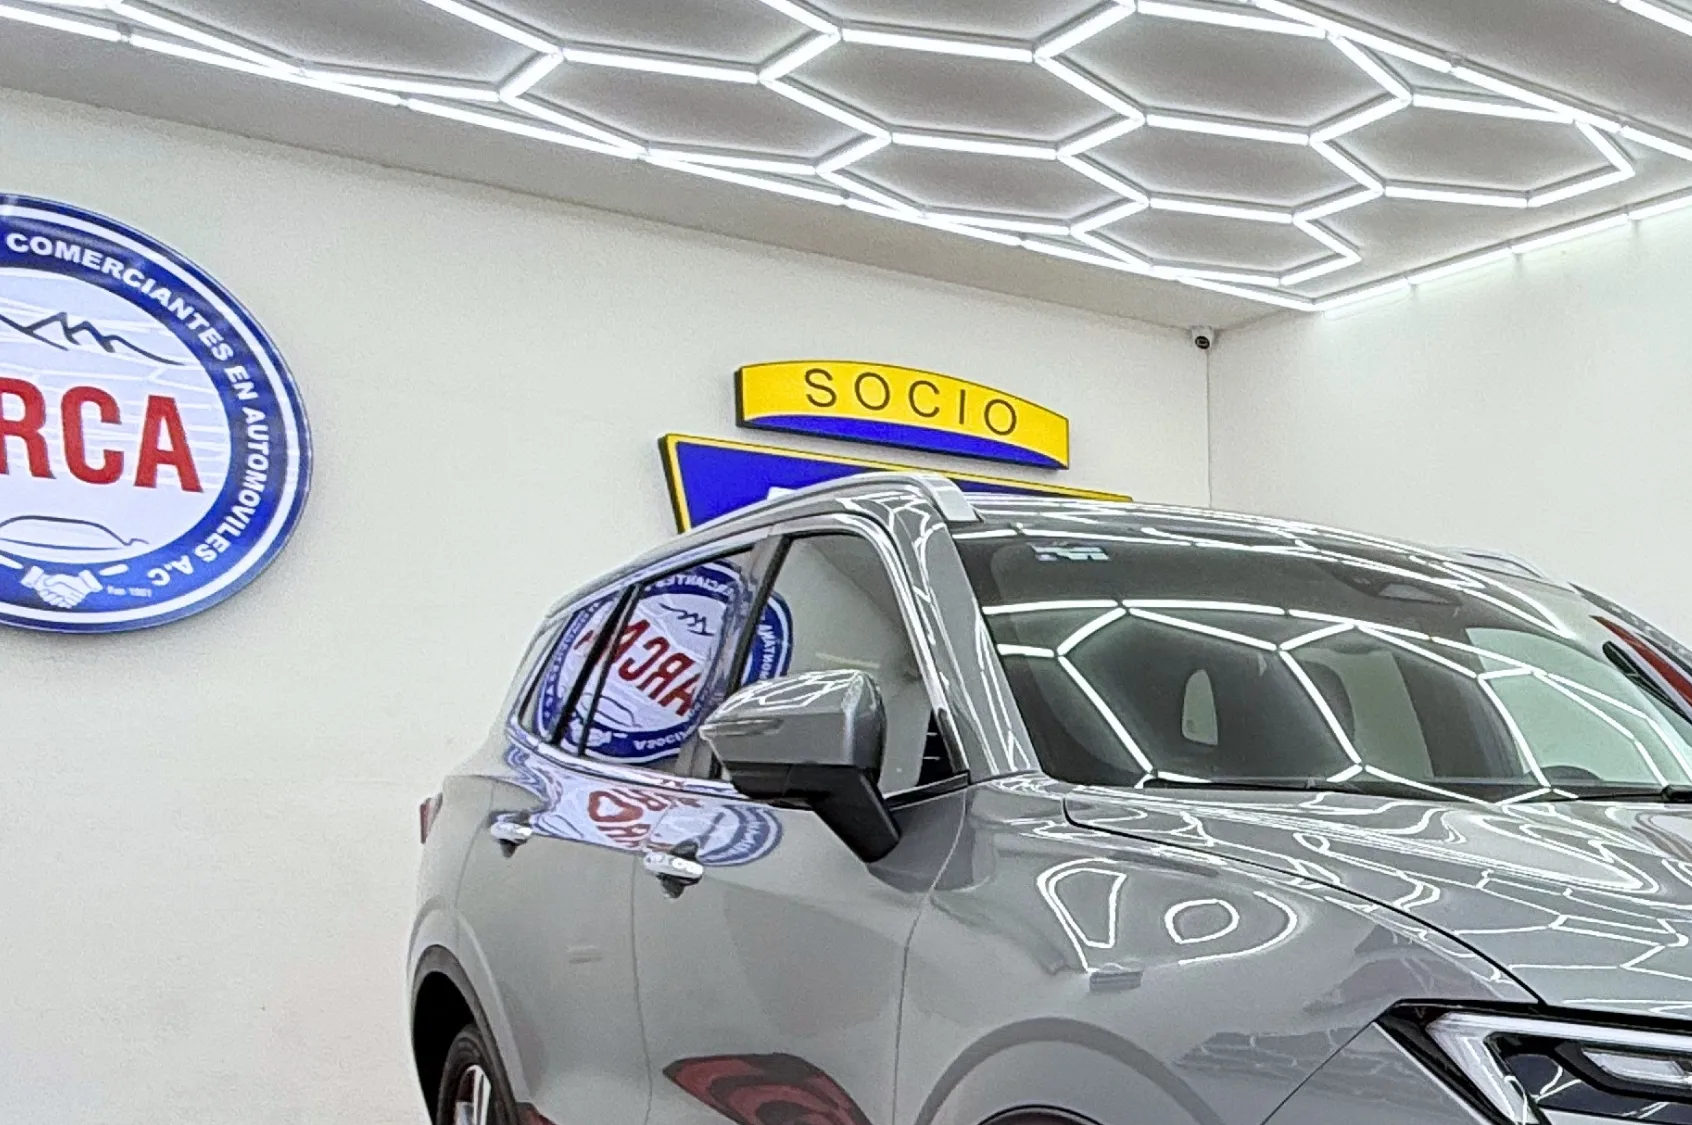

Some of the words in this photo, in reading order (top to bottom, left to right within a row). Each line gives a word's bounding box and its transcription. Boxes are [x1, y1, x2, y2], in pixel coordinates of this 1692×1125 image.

[6, 232, 234, 361] COMERCIANTES
[224, 365, 258, 400] EN
[804, 367, 1017, 436] SOCIO
[194, 406, 269, 563] AUTOMOVILES
